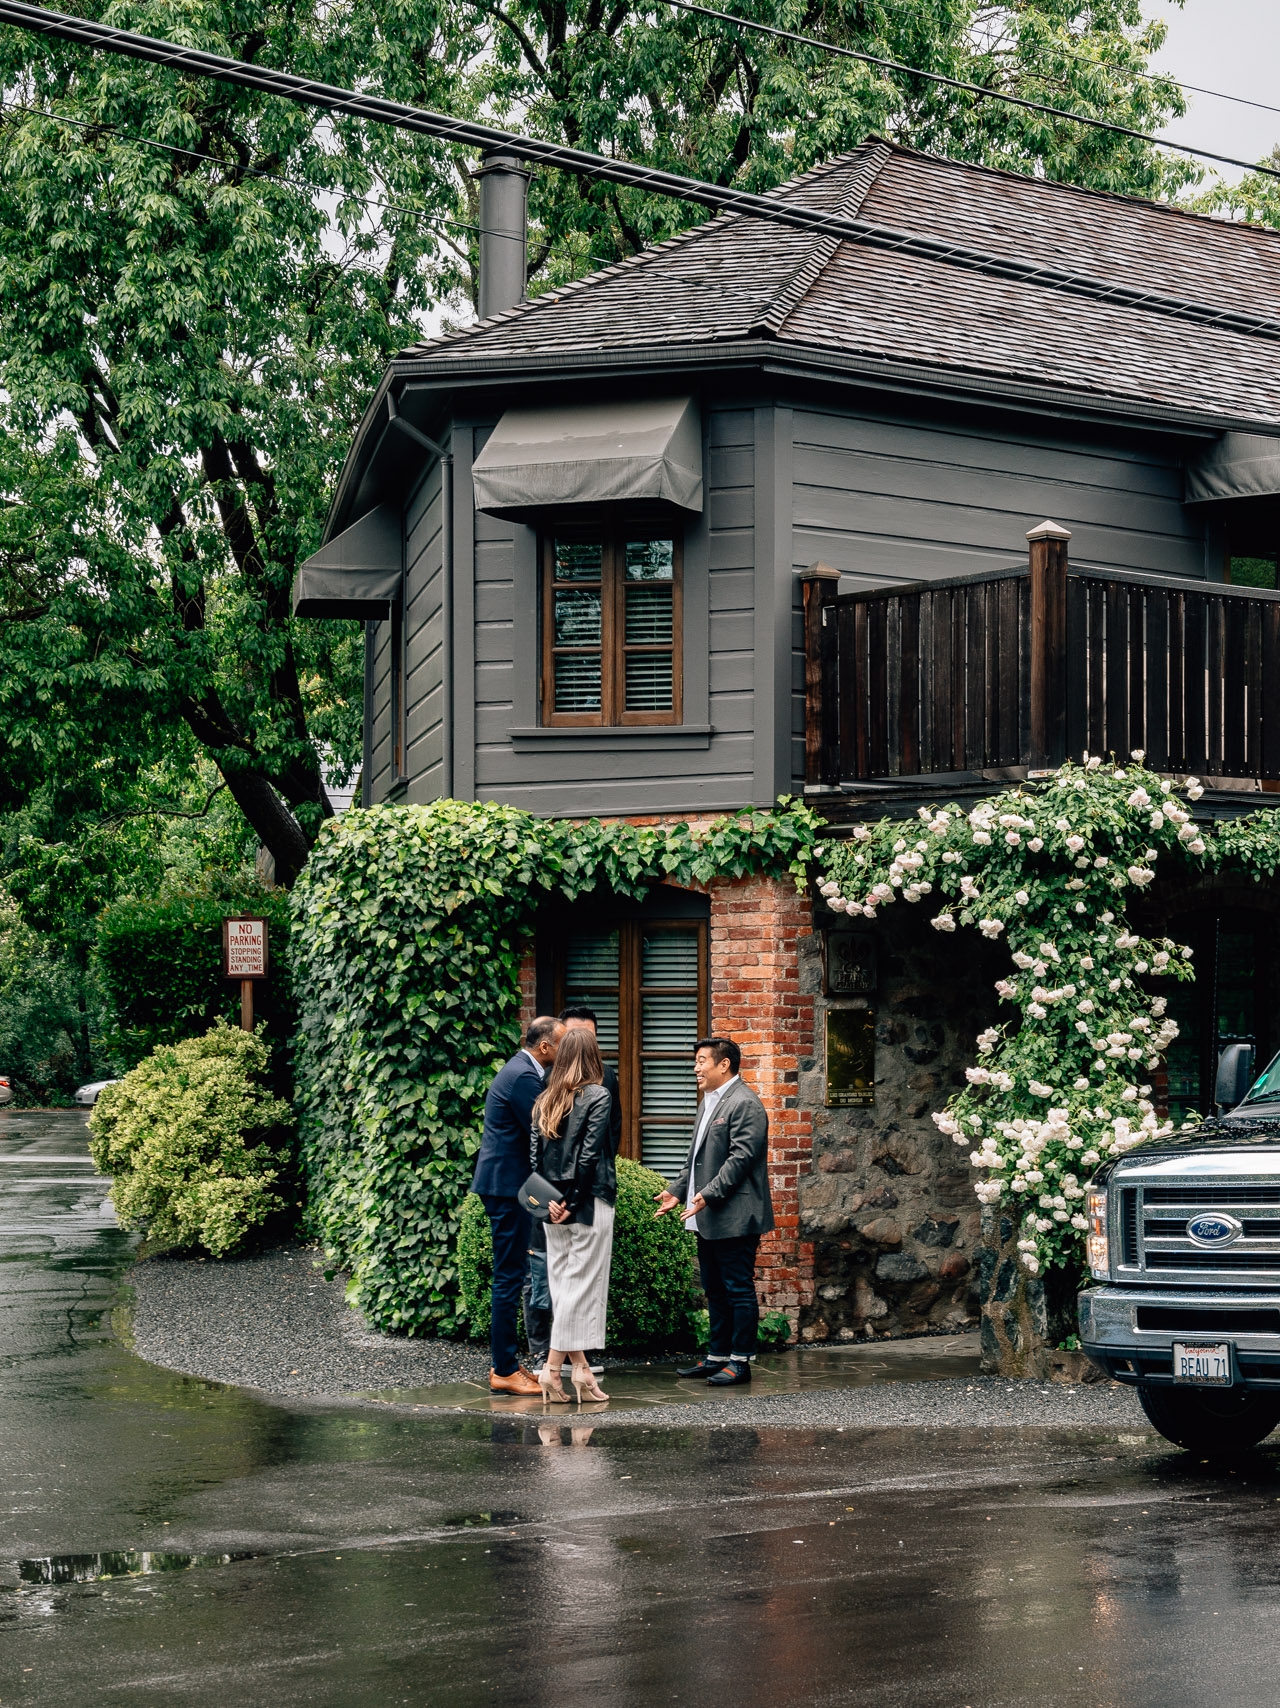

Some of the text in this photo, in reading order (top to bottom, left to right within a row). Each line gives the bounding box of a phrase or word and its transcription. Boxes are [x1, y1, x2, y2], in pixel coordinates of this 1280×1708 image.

[238, 924, 252, 934] NO
[230, 936, 262, 946] PARKING
[248, 964, 263, 972] TIME
[1197, 1221, 1221, 1236] Ford
[1184, 1346, 1220, 1356] California
[1180, 1357, 1228, 1377] BEAU 71
